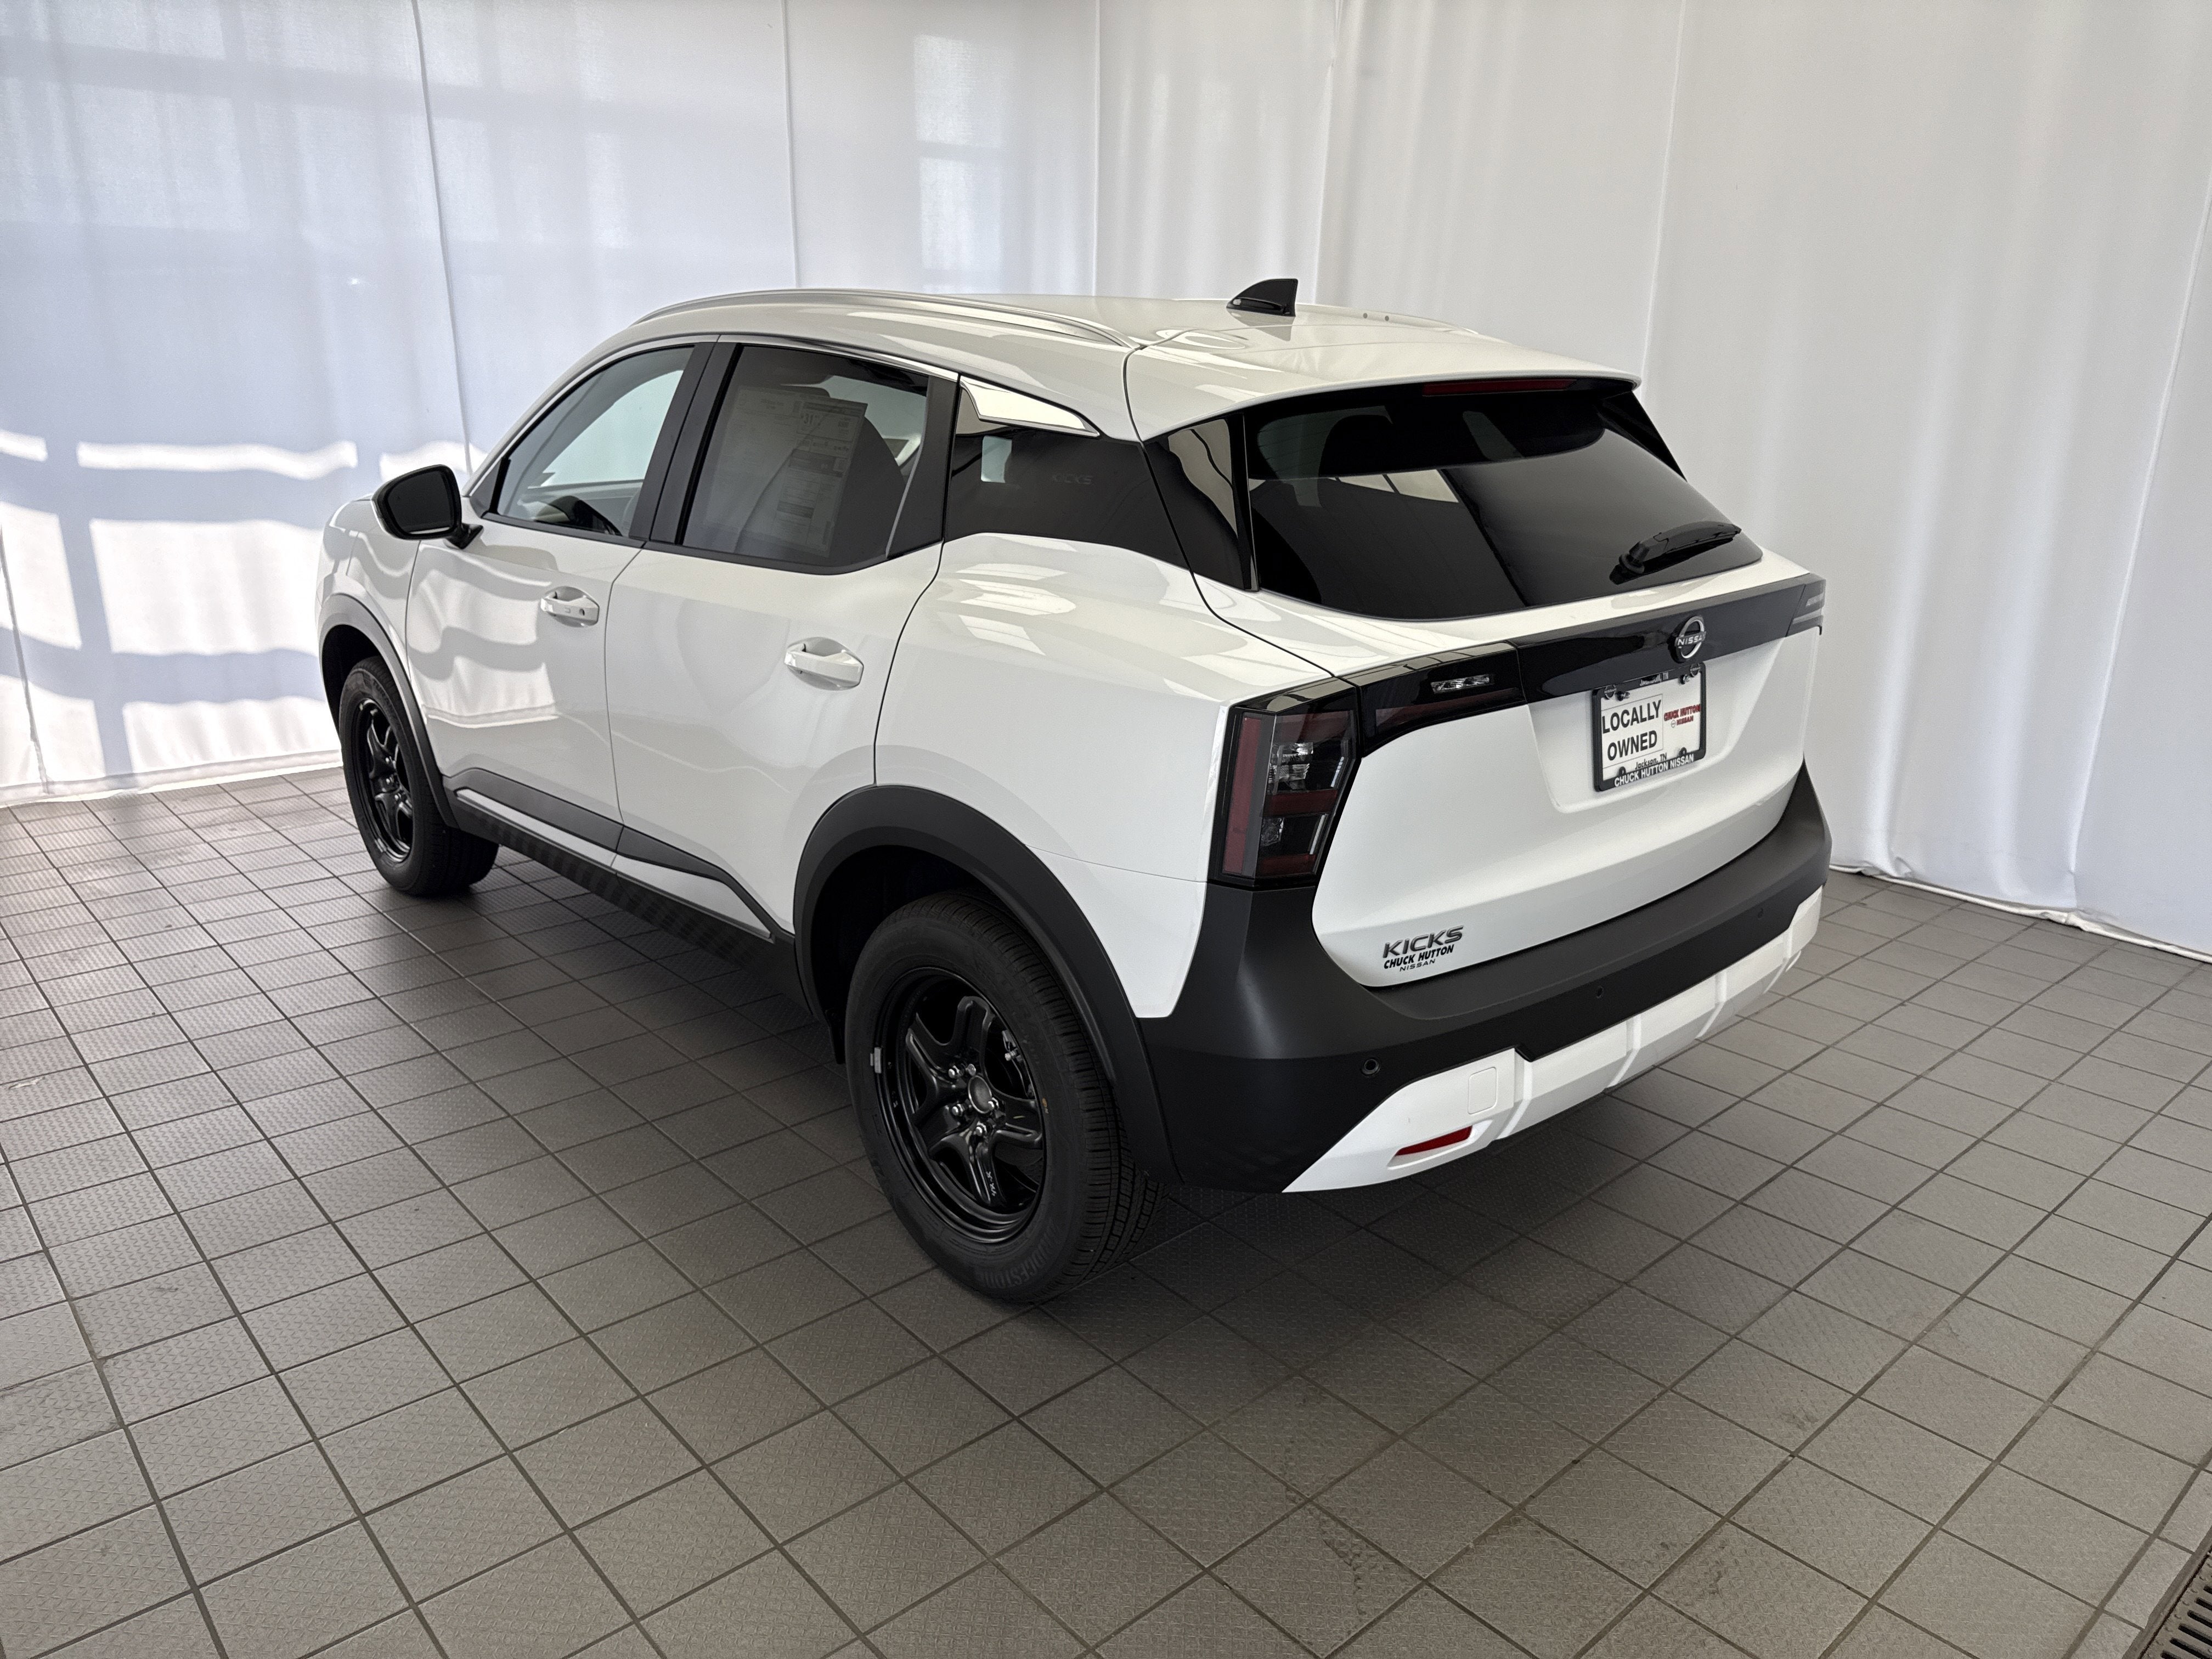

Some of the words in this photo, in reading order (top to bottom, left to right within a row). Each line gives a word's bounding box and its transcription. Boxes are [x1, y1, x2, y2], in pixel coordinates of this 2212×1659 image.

[1602, 699, 1661, 734] LOCALLY
[1607, 730, 1657, 761] OWNED
[1660, 753, 1667, 761] TN
[1615, 771, 1639, 787] CHUCK
[1641, 761, 1668, 778] HUTTON
[1670, 753, 1694, 769] NISSAN
[1383, 925, 1464, 958] KICKS
[1384, 953, 1416, 969] CHUCK
[1418, 944, 1455, 962] HUTTON
[1400, 958, 1435, 972] NISSAN
